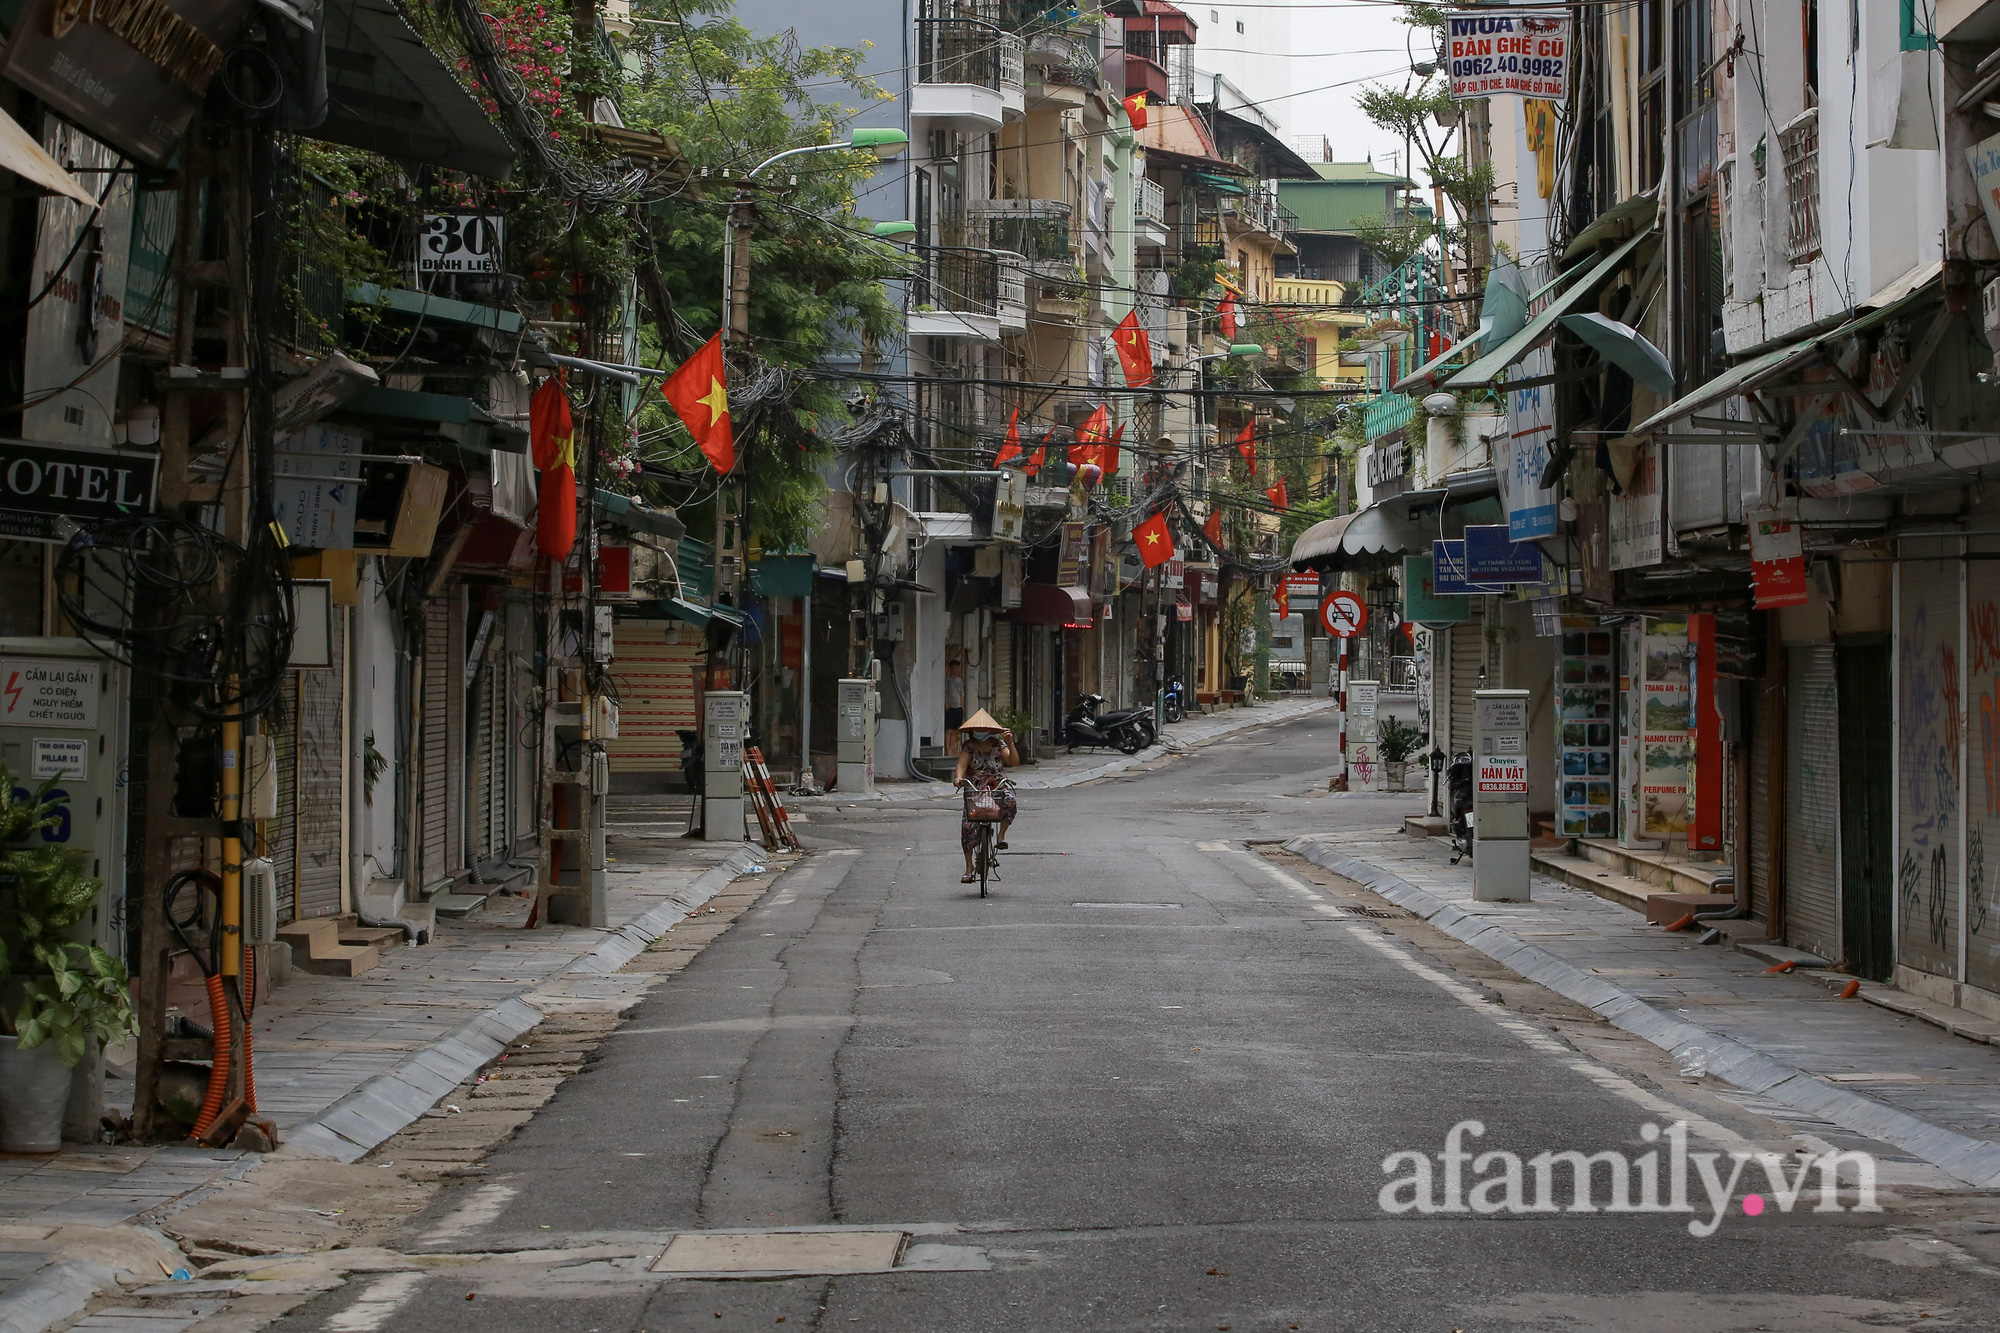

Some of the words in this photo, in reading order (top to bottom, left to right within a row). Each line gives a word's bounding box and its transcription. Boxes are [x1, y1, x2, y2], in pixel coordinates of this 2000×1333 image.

[1451, 16, 1514, 37] MUA
[1452, 37, 1492, 58] BÀN
[1497, 34, 1534, 55] GHẾ
[1538, 38, 1564, 58] CŨ
[1452, 55, 1563, 78] 0962.40.9982
[1520, 77, 1533, 92] GHẾ
[428, 216, 499, 256] 30
[467, 257, 499, 273] LIỆ
[1518, 373, 1541, 412] SPA
[0, 457, 143, 507] OTEL
[25, 667, 47, 682] CẤM
[49, 671, 65, 685] LẠI
[40, 686, 53, 695] CÓ
[1644, 684, 1664, 692] TRANG
[1665, 684, 1674, 692] AN
[1679, 684, 1688, 692] BA
[33, 699, 59, 707] NGUY
[29, 708, 54, 719] CHẾT
[1644, 735, 1666, 743] HANOI
[1668, 735, 1684, 743] CITY
[41, 754, 68, 763] PILLAR
[1489, 757, 1518, 765] Chuyên:
[1481, 765, 1502, 779] HÀN
[1677, 786, 1687, 794] PA
